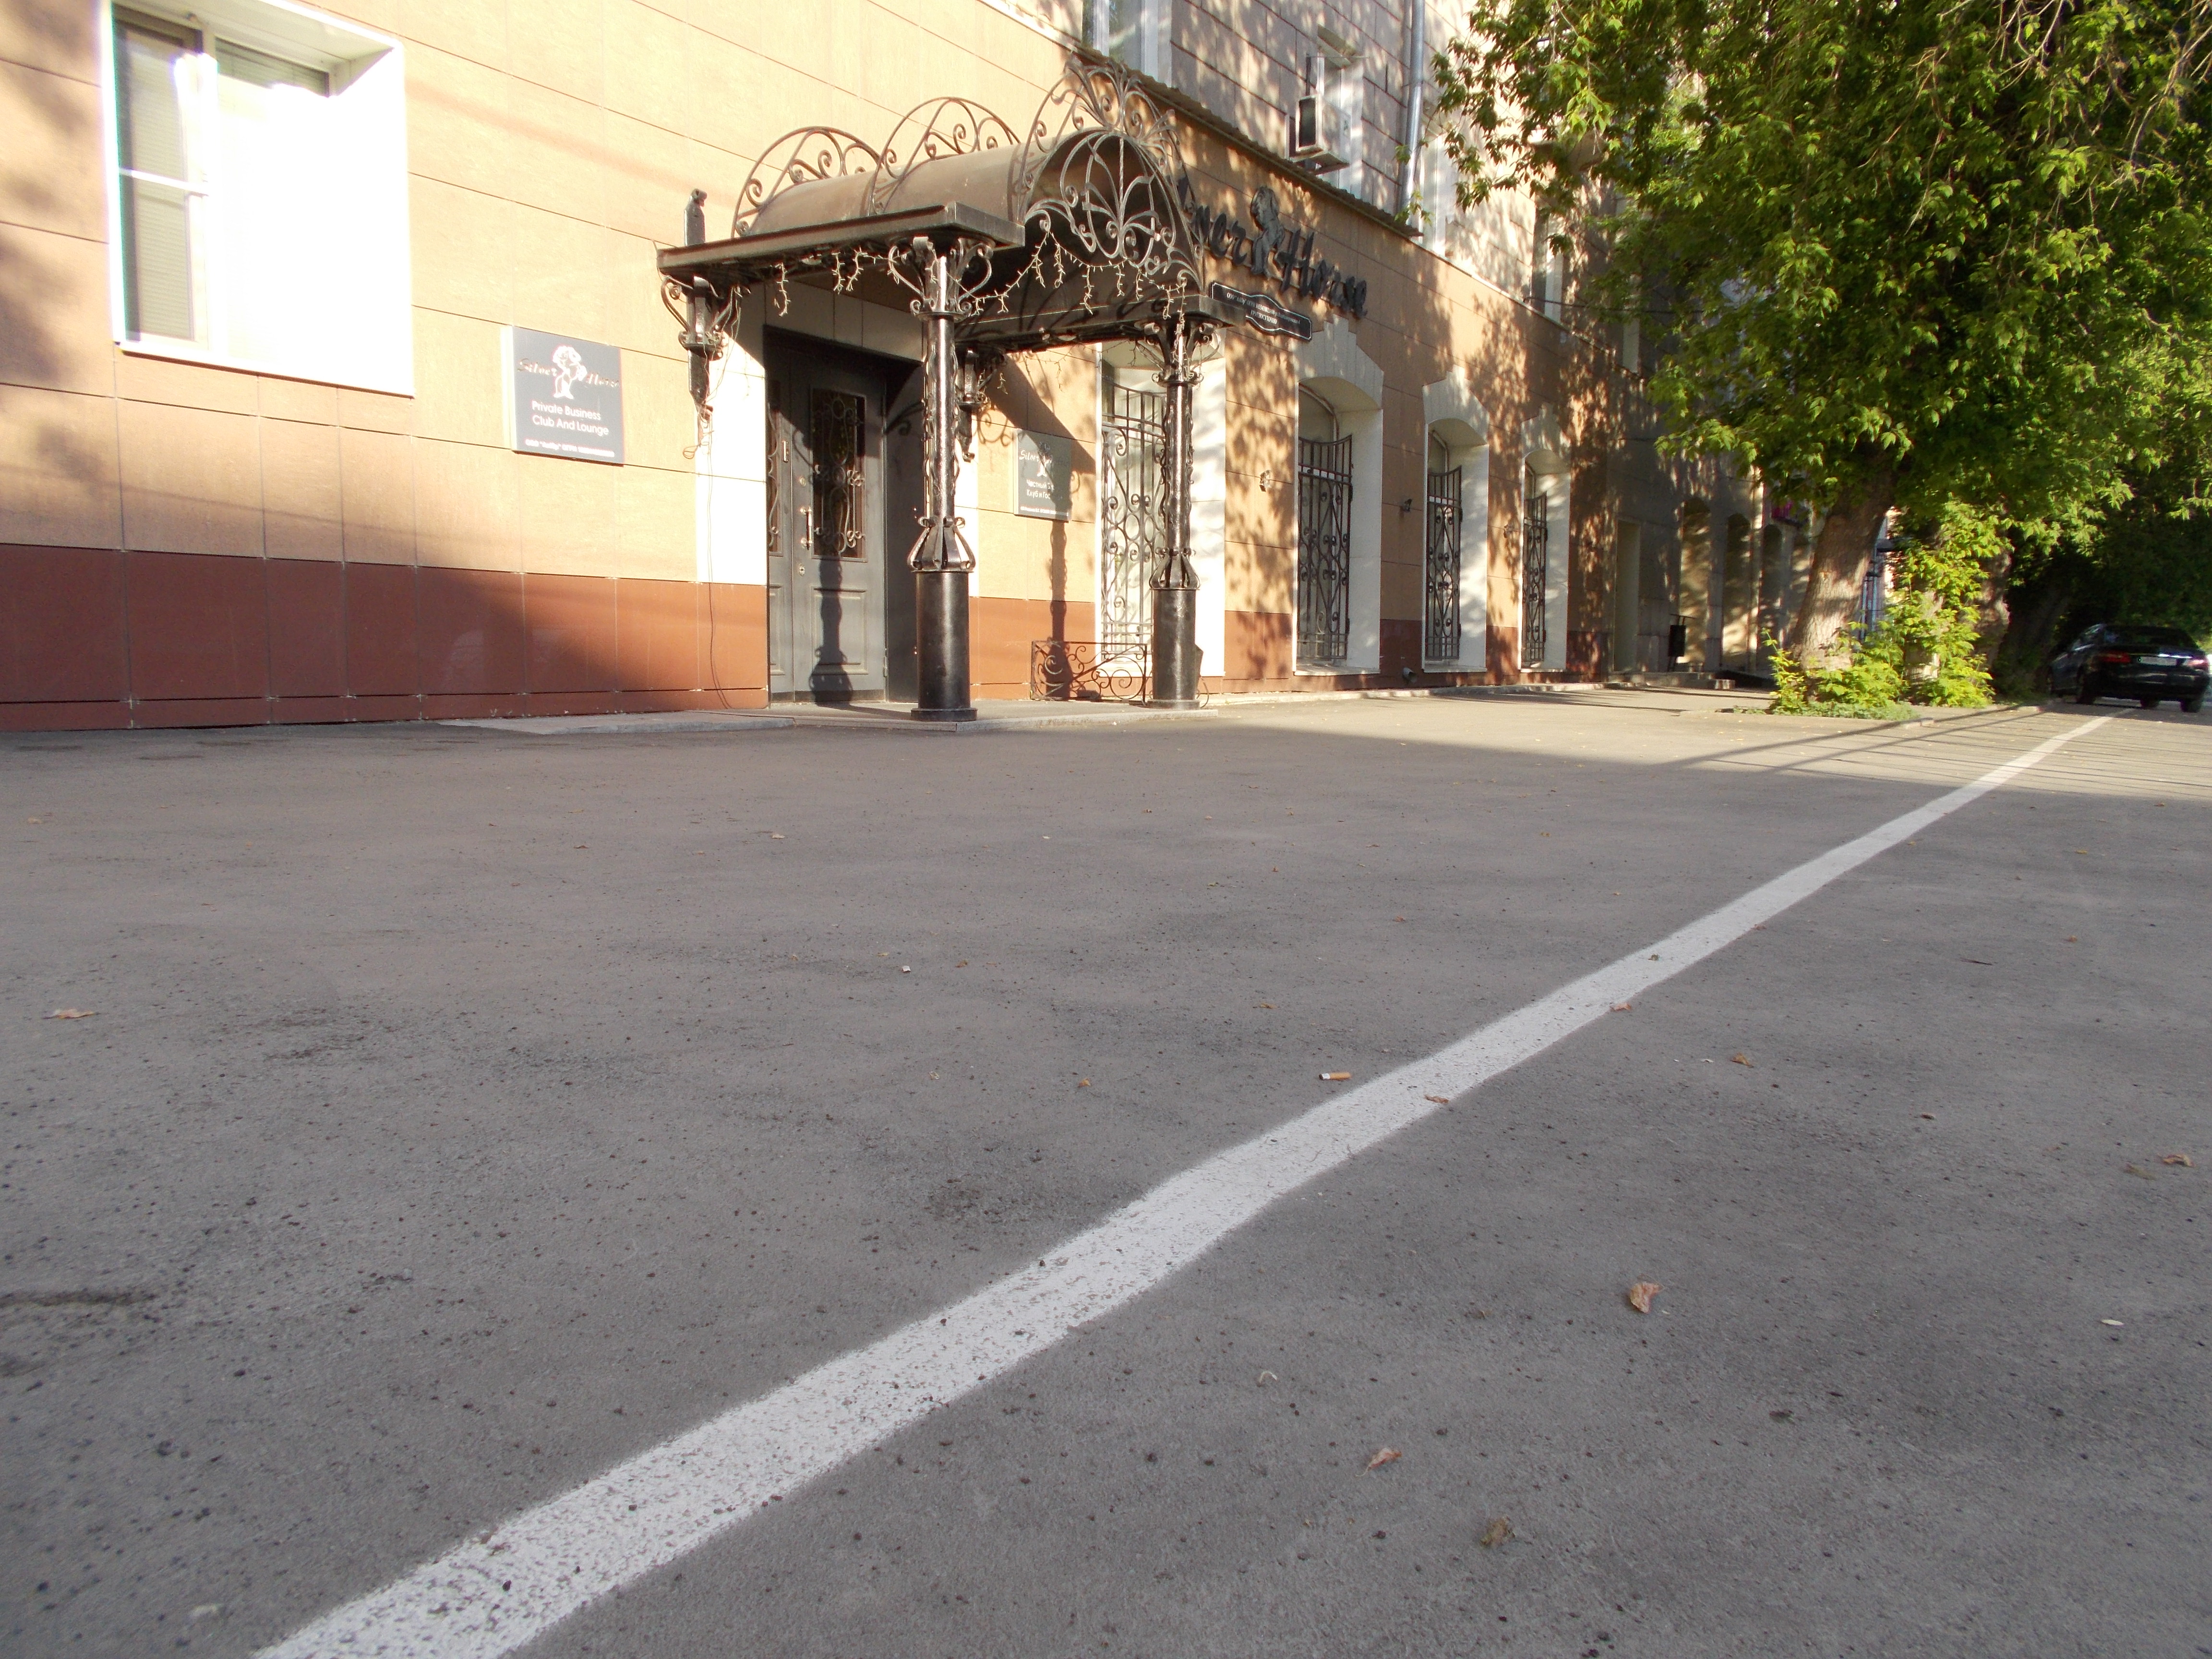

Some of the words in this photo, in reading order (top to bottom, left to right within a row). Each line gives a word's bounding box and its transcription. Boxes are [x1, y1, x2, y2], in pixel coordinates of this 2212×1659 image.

[531, 400, 563, 414] Private
[565, 406, 601, 421] Business
[532, 415, 554, 428] Club
[557, 420, 575, 430] And
[577, 421, 609, 436] Lounge
[1027, 489, 1038, 499] Клуб
